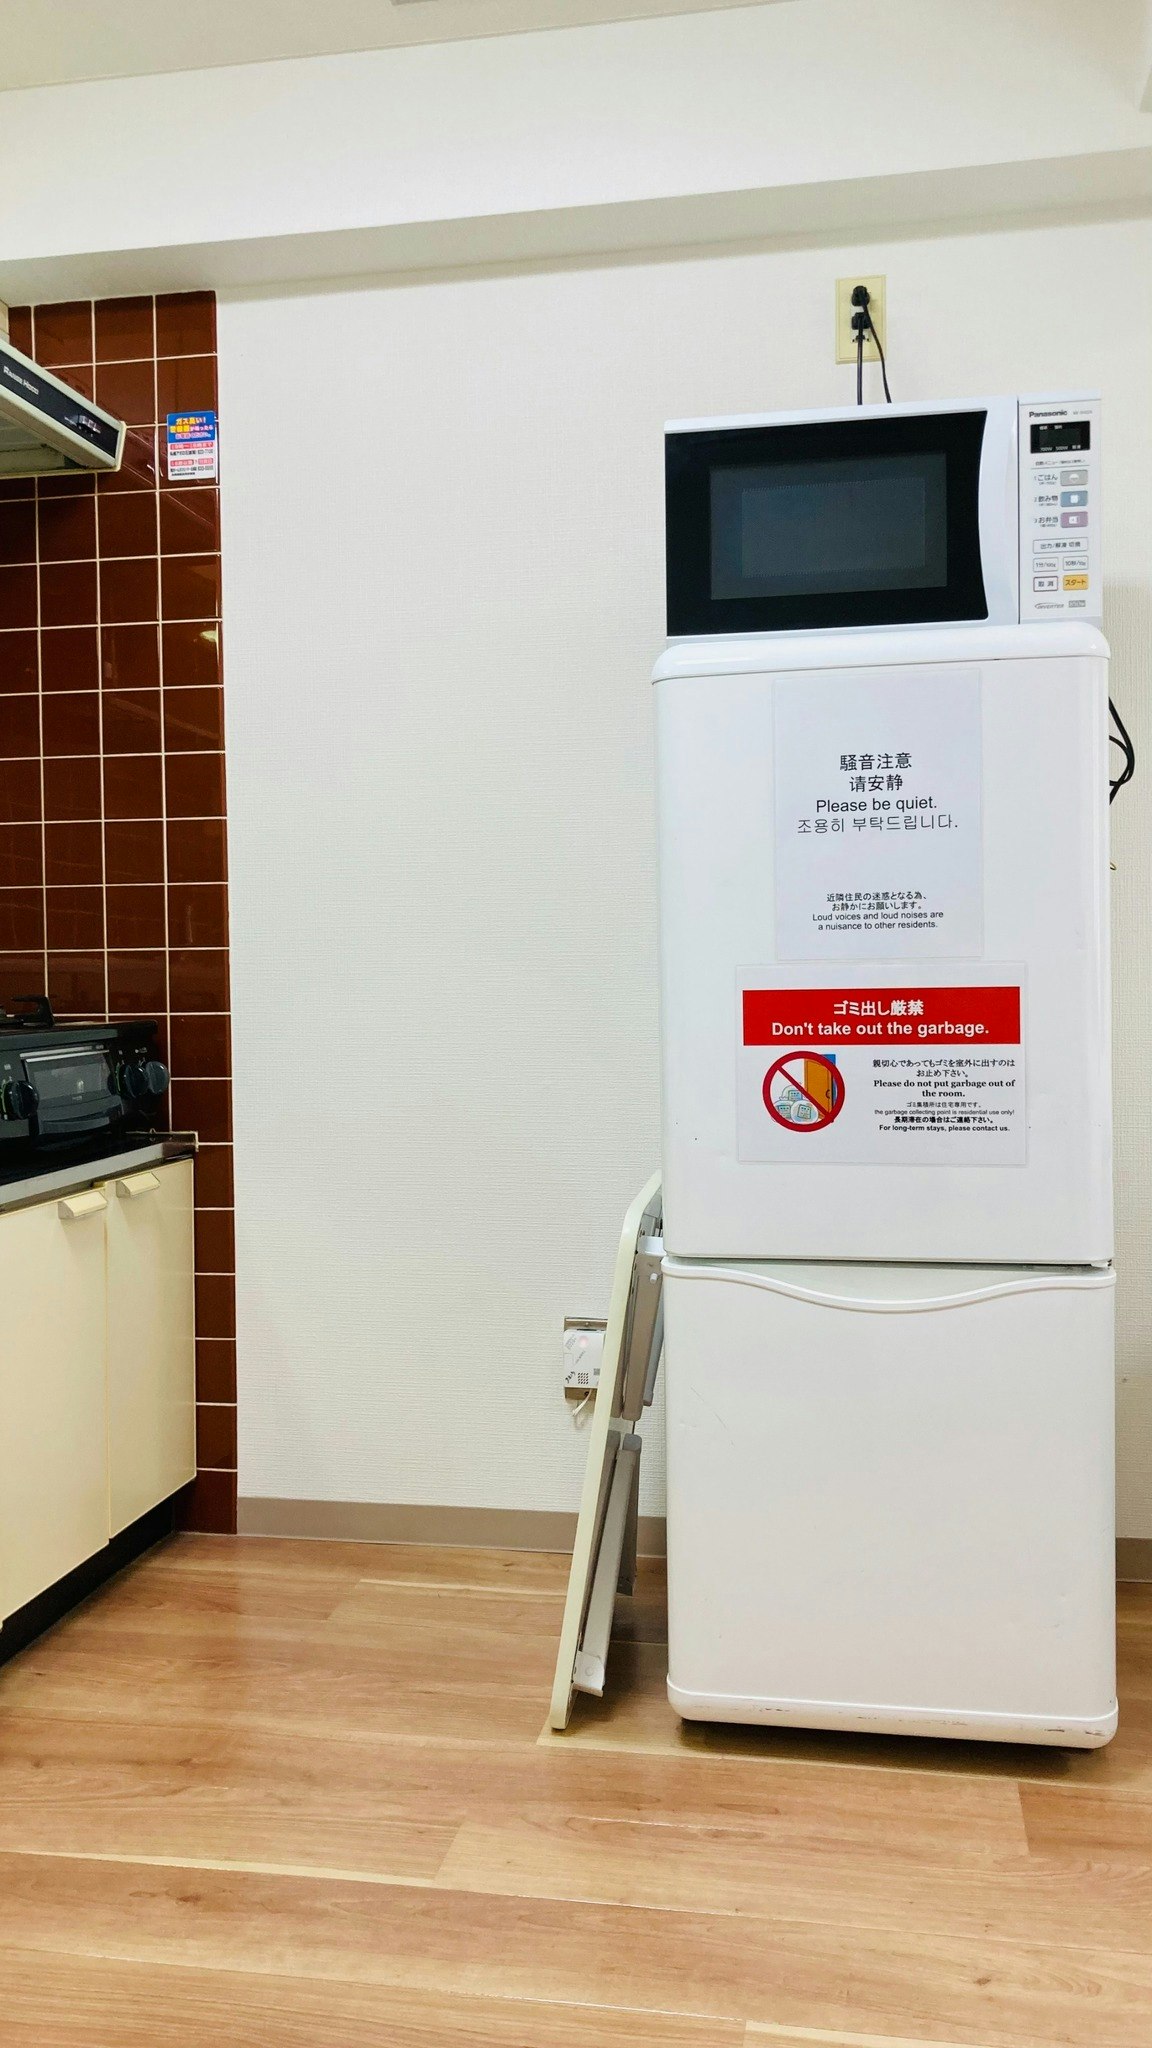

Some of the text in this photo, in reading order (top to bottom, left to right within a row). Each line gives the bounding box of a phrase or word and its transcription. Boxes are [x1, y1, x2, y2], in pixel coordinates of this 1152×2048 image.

[840, 752, 912, 772] 騒音注意
[849, 774, 904, 793] 请安静
[816, 796, 937, 813] Please be quiet.
[797, 814, 958, 834] 조용히 부탁드립니다.
[832, 901, 922, 912] お静かにお願いします。
[812, 913, 833, 921] Loud
[835, 913, 861, 921] voices
[863, 912, 879, 920] and
[881, 911, 899, 920] loud
[901, 911, 928, 919] noises
[826, 922, 862, 930] nuisance
[864, 922, 873, 930] to
[874, 921, 895, 930] other
[898, 921, 938, 929] residents.
[833, 1000, 925, 1016] ゴミ出し厳禁
[772, 1021, 990, 1038] Don't take out the garbage.
[916, 1070, 969, 1078] お止め下さい。
[934, 1080, 949, 1089] put
[951, 1080, 987, 1089] garbage
